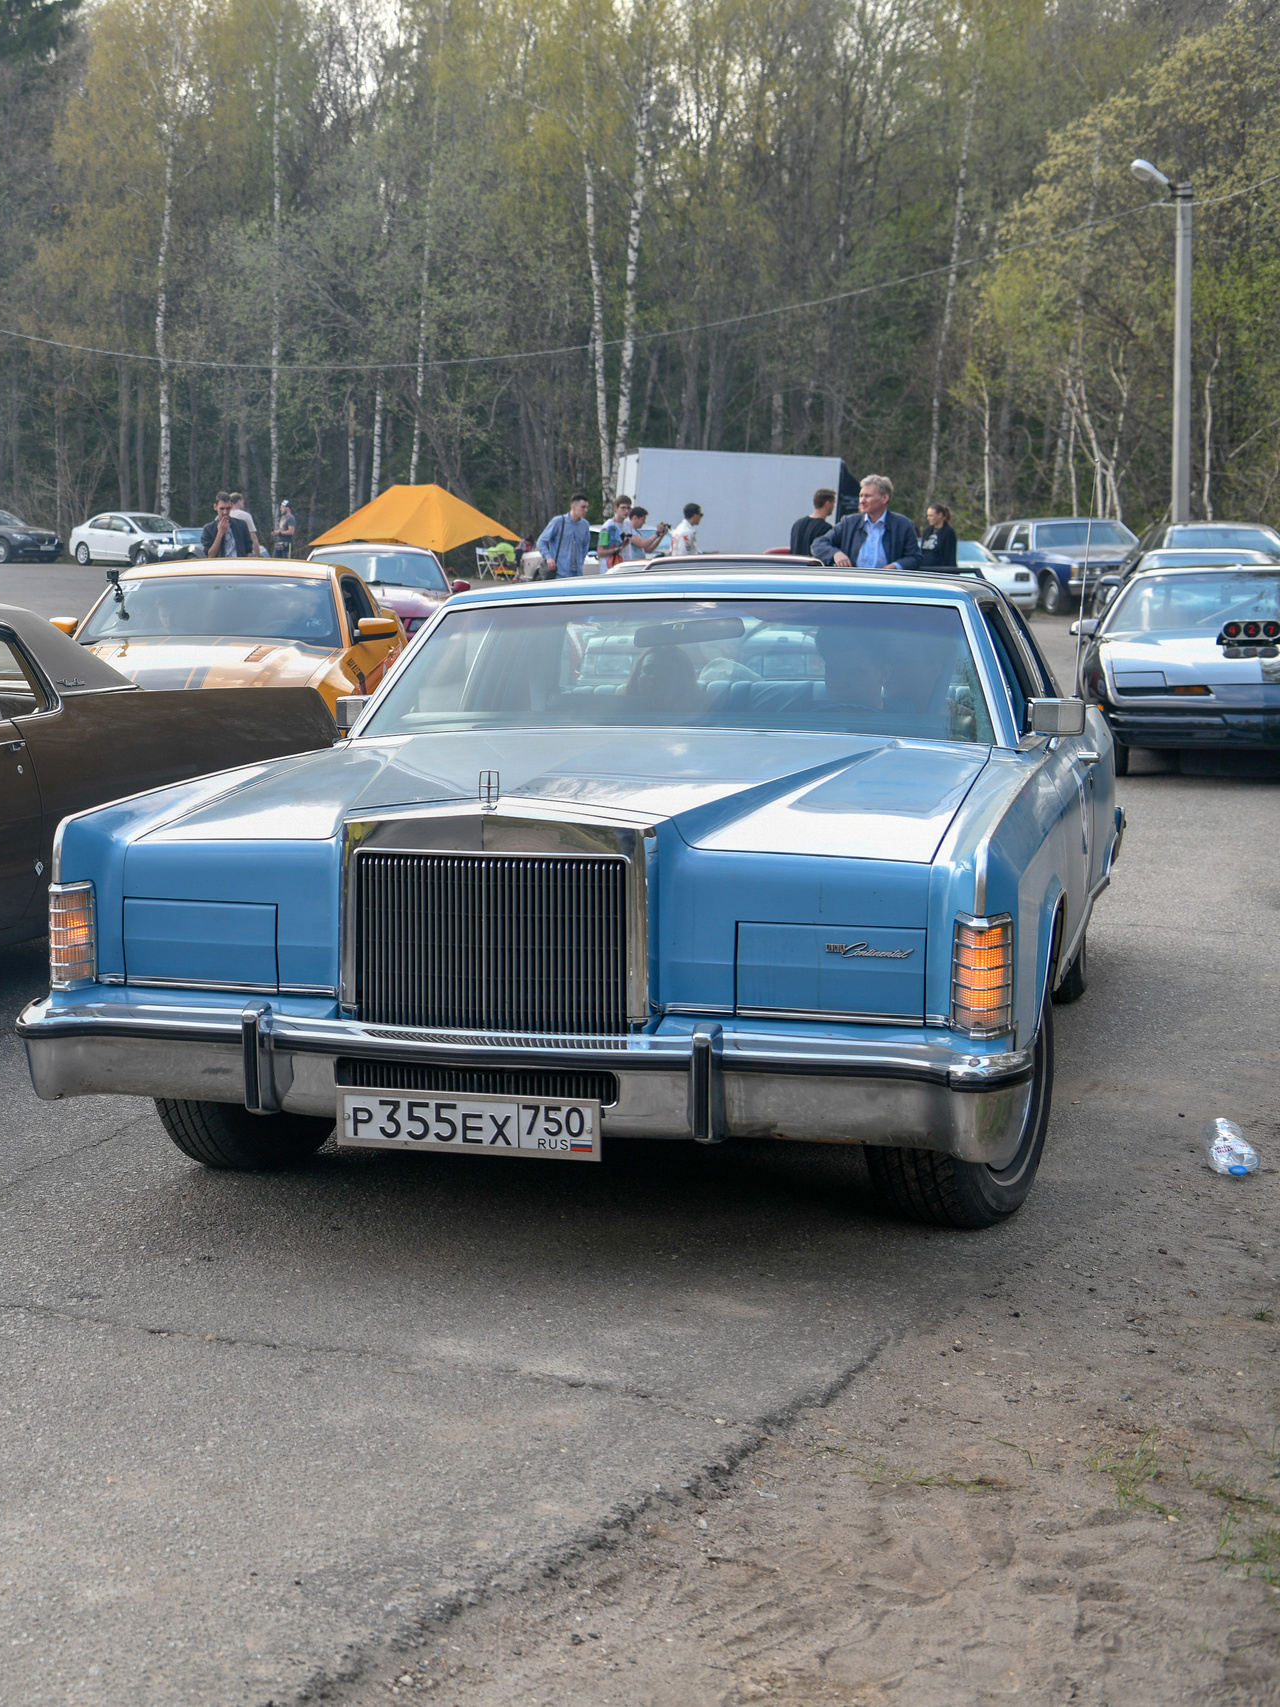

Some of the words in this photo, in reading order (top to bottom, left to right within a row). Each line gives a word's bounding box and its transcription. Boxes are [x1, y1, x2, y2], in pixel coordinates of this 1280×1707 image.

[841, 941, 914, 959] Continental
[521, 1104, 585, 1138] 750
[537, 1138, 569, 1151] RUS
